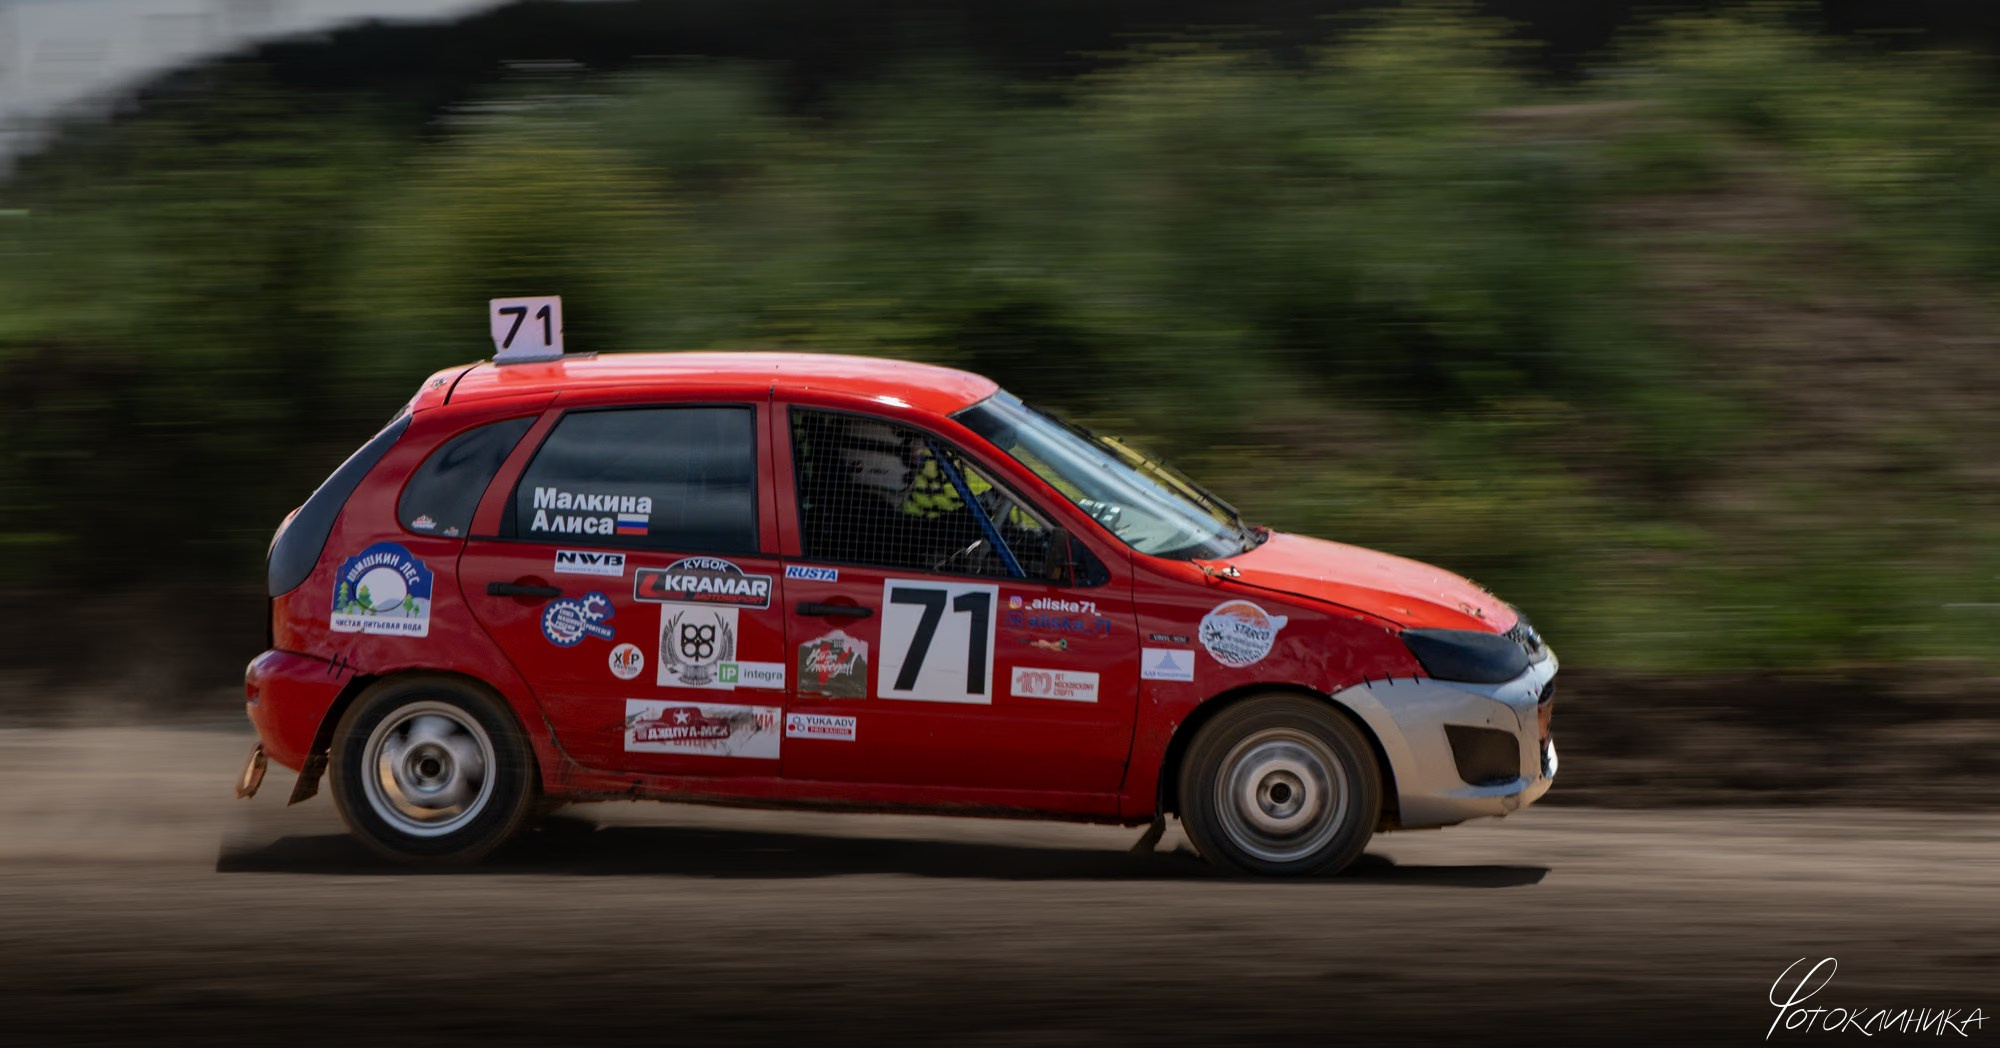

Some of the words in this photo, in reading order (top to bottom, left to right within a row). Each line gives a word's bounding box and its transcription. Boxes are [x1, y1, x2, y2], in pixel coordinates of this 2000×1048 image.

[499, 305, 552, 349] 71
[533, 487, 653, 514] Малкина
[530, 510, 614, 535] Алиса
[347, 552, 400, 582] ШИШКИН
[400, 561, 420, 586] ЛЕС
[556, 552, 623, 566] NWB
[683, 559, 729, 573] КУБОК
[786, 566, 838, 581] RUSTA
[665, 575, 768, 597] KRAMAR
[1025, 597, 1102, 617] _aliska71_
[335, 619, 361, 628] ЧИСТАЯ
[363, 621, 400, 630] ПИТЬЕВАЯ
[402, 623, 422, 632] ВОДА
[1027, 615, 1111, 635] aliska_71
[890, 587, 991, 695] 71
[721, 666, 737, 680] IP
[744, 668, 784, 681] integra
[806, 716, 834, 726] YUKA
[834, 717, 855, 727] ADV
